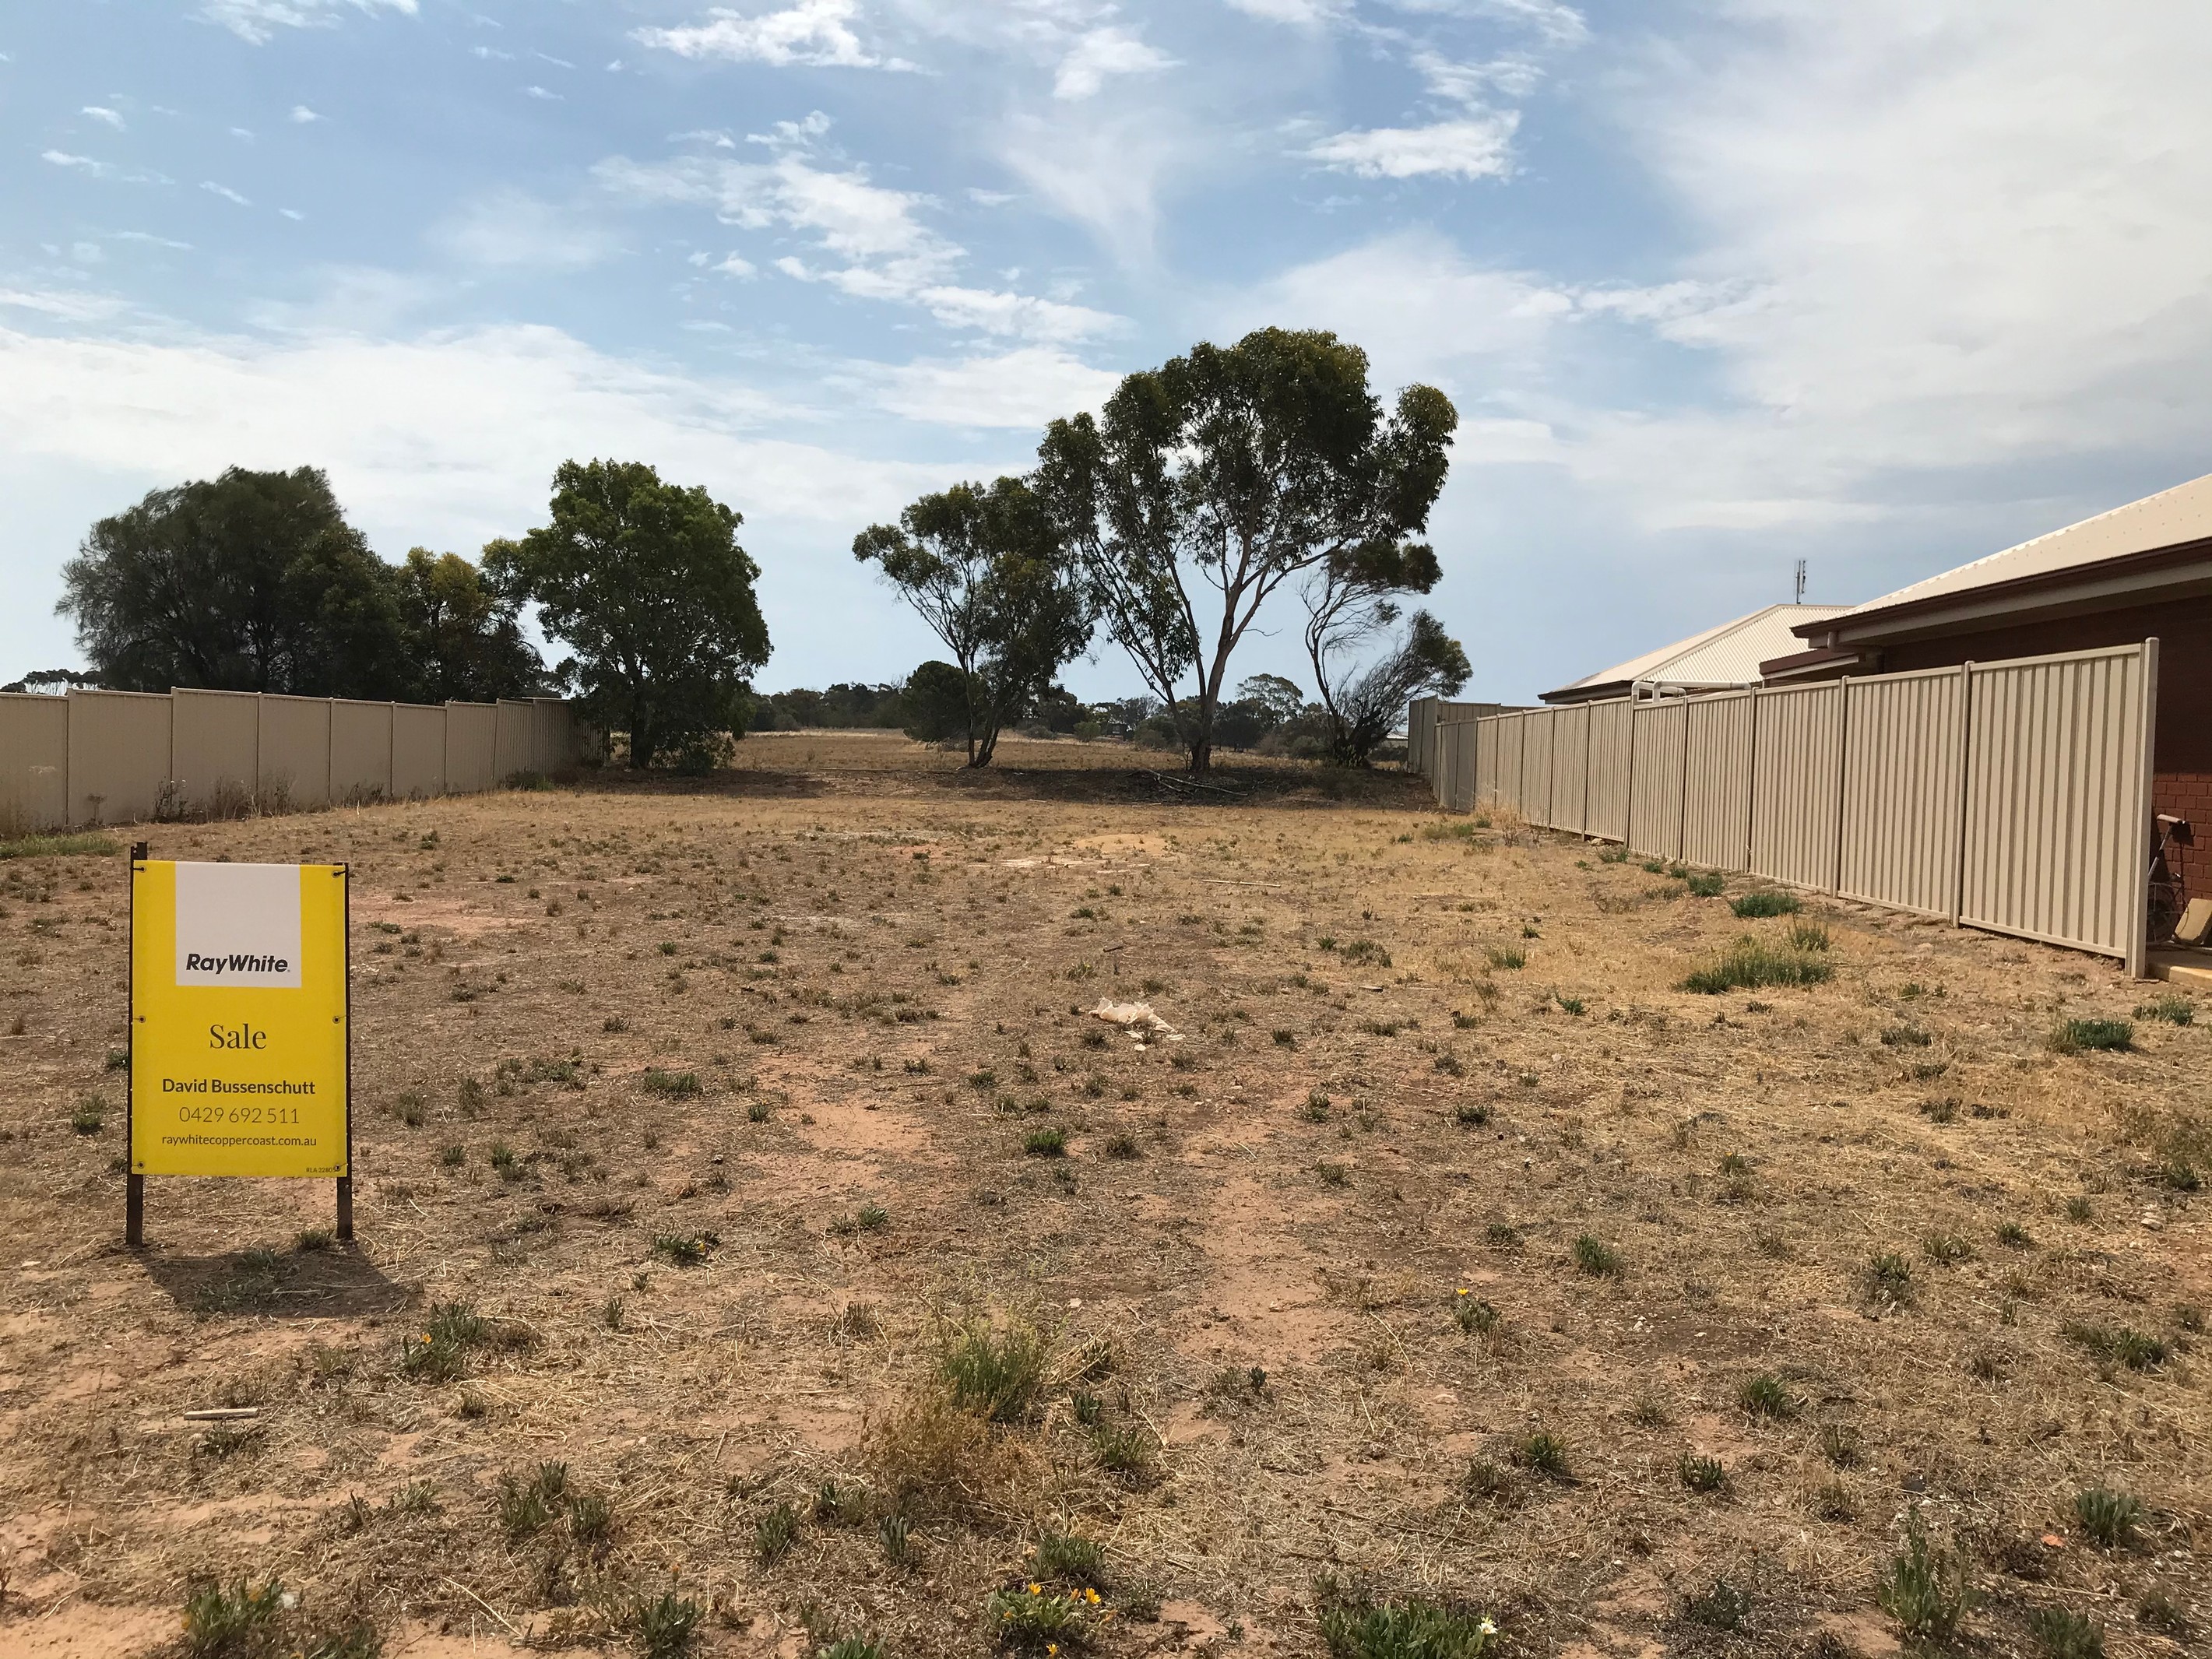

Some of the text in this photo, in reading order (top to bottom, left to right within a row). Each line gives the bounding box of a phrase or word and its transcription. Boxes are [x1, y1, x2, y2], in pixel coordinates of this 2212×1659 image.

[209, 1023, 267, 1049] Sale
[163, 1078, 315, 1095] David Bussenschutt
[179, 1106, 300, 1124] 0429 692 511
[162, 1134, 317, 1147] raywhitecoppercoast.com.au
